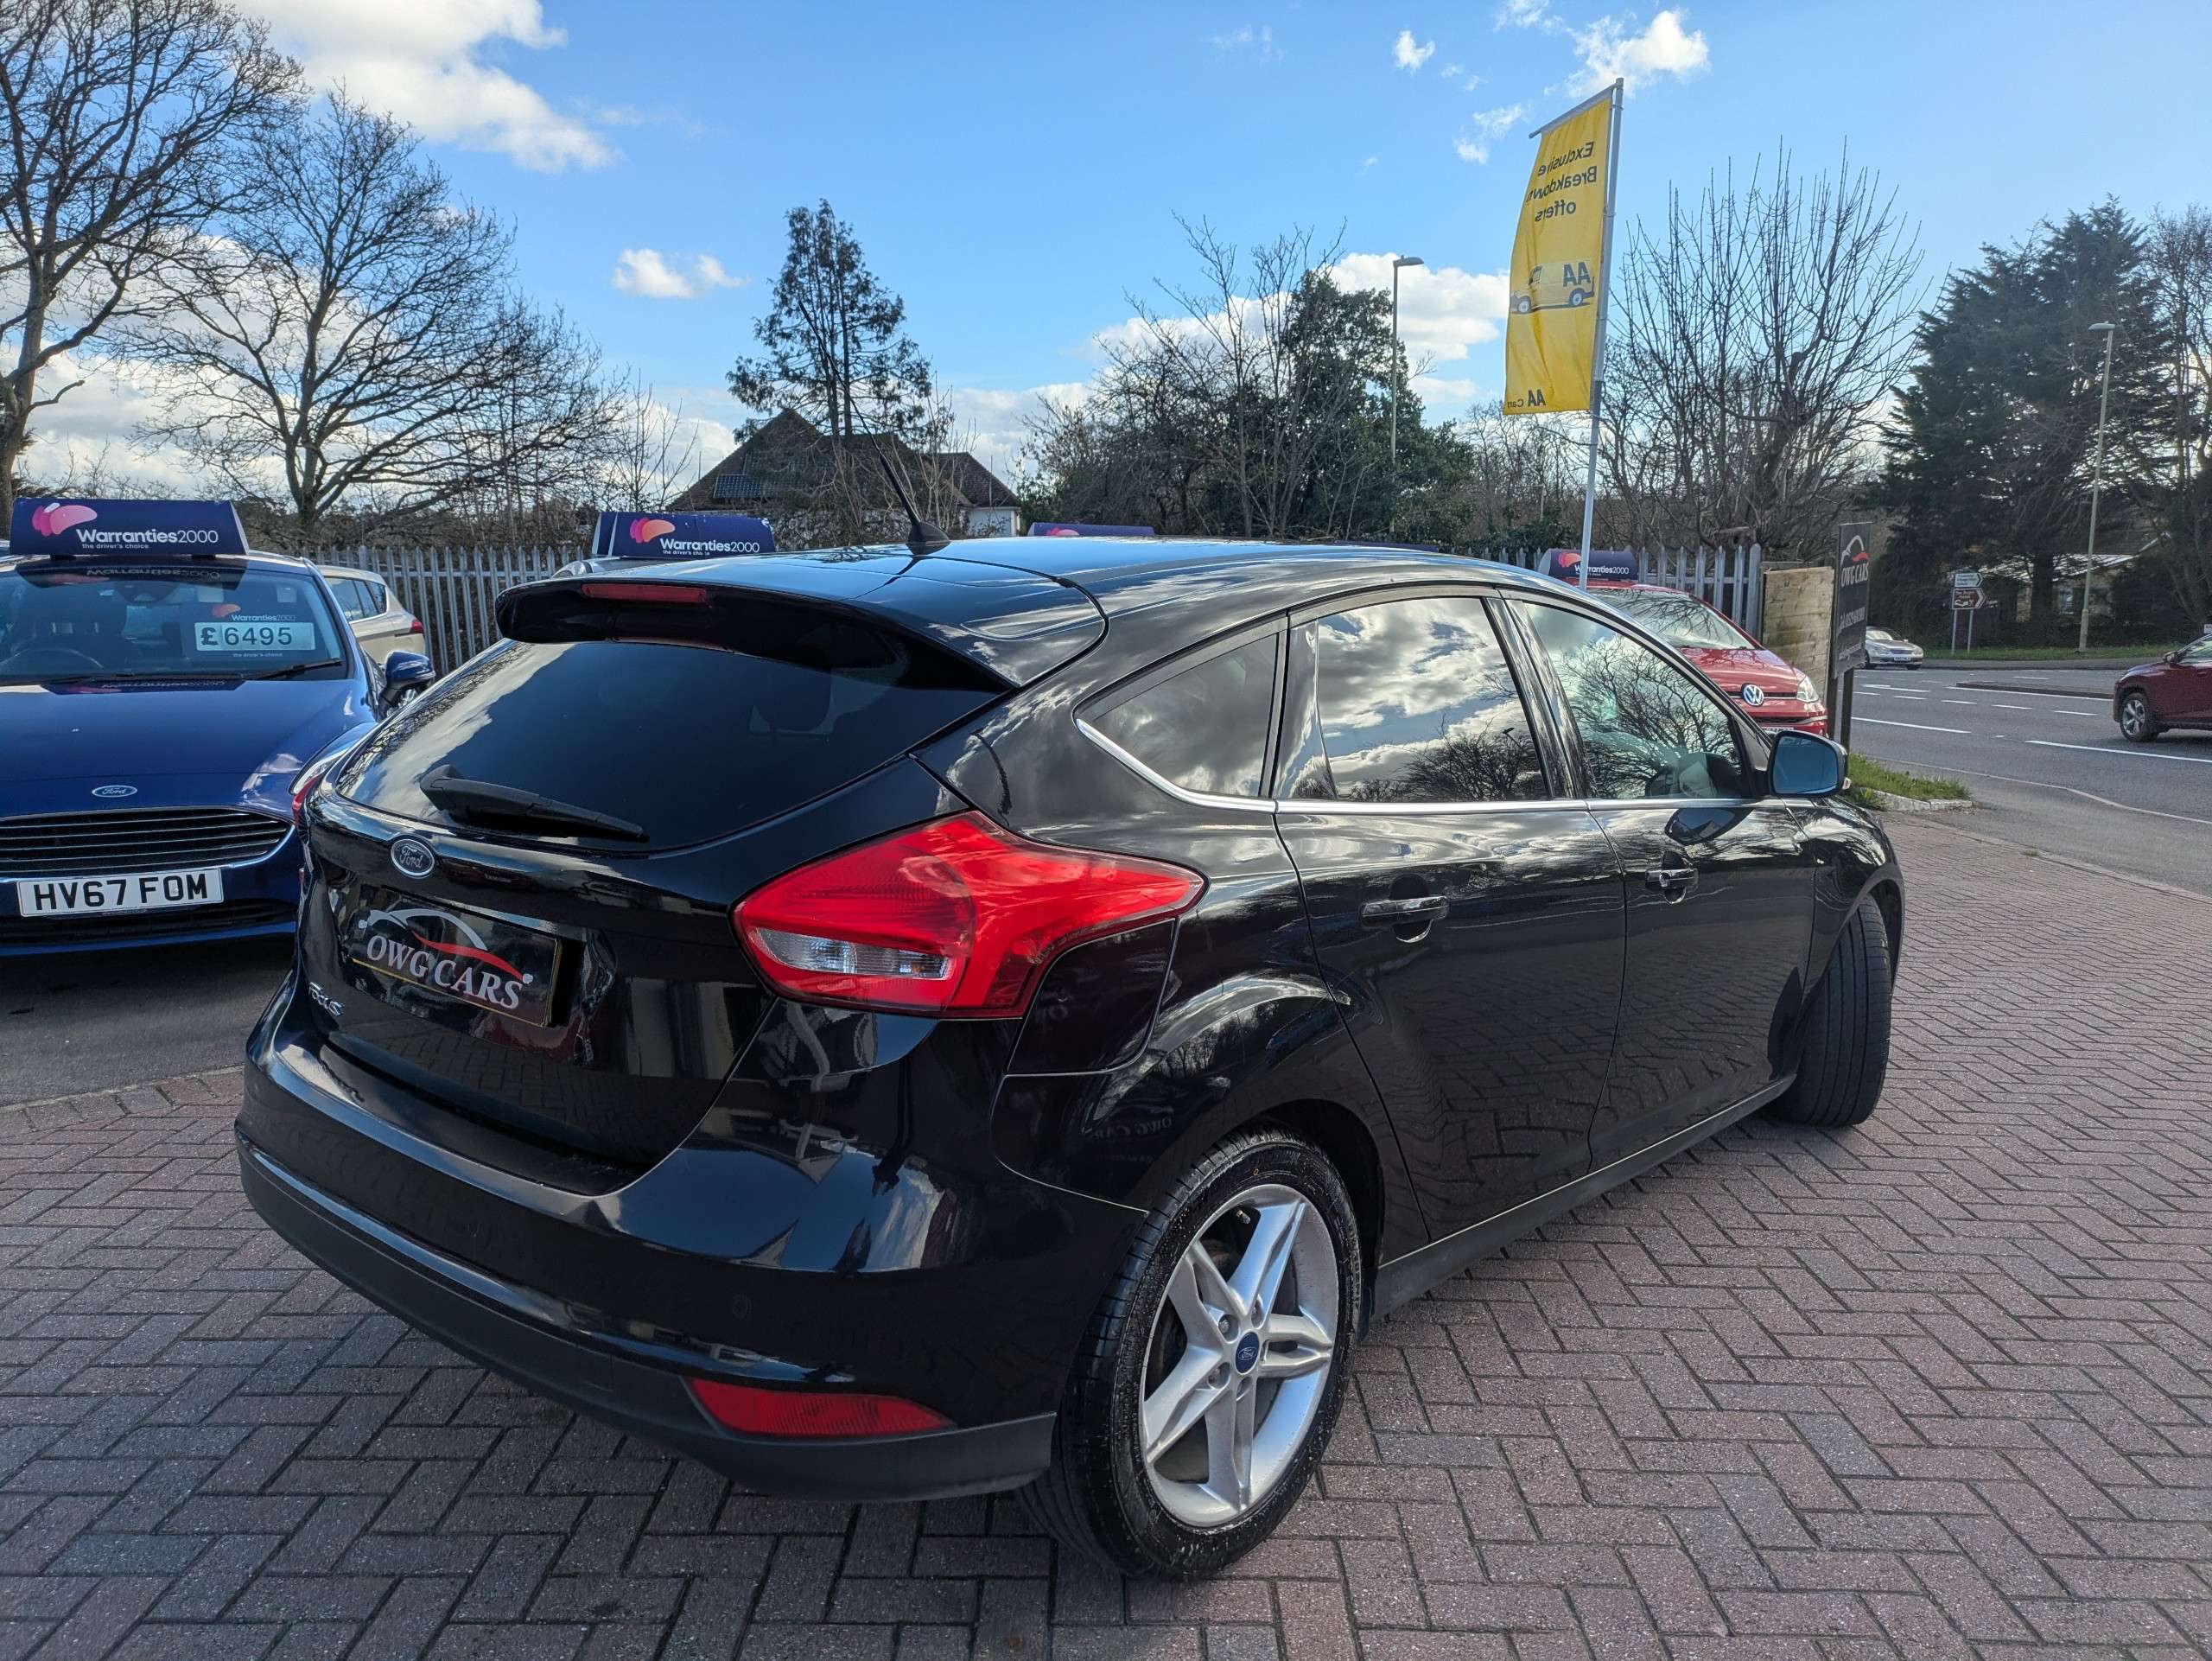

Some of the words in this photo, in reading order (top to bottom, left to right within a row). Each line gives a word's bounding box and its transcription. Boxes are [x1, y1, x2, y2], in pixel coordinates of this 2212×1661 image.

[76, 528, 219, 544] Warranties2000
[659, 538, 760, 553] Warranties2000
[1574, 564, 1629, 574] Wranties2000
[399, 845, 424, 869] Ford
[34, 880, 127, 911] HV67
[139, 873, 208, 904] FOM
[366, 935, 429, 978] OWG
[434, 959, 524, 1010] CARS
